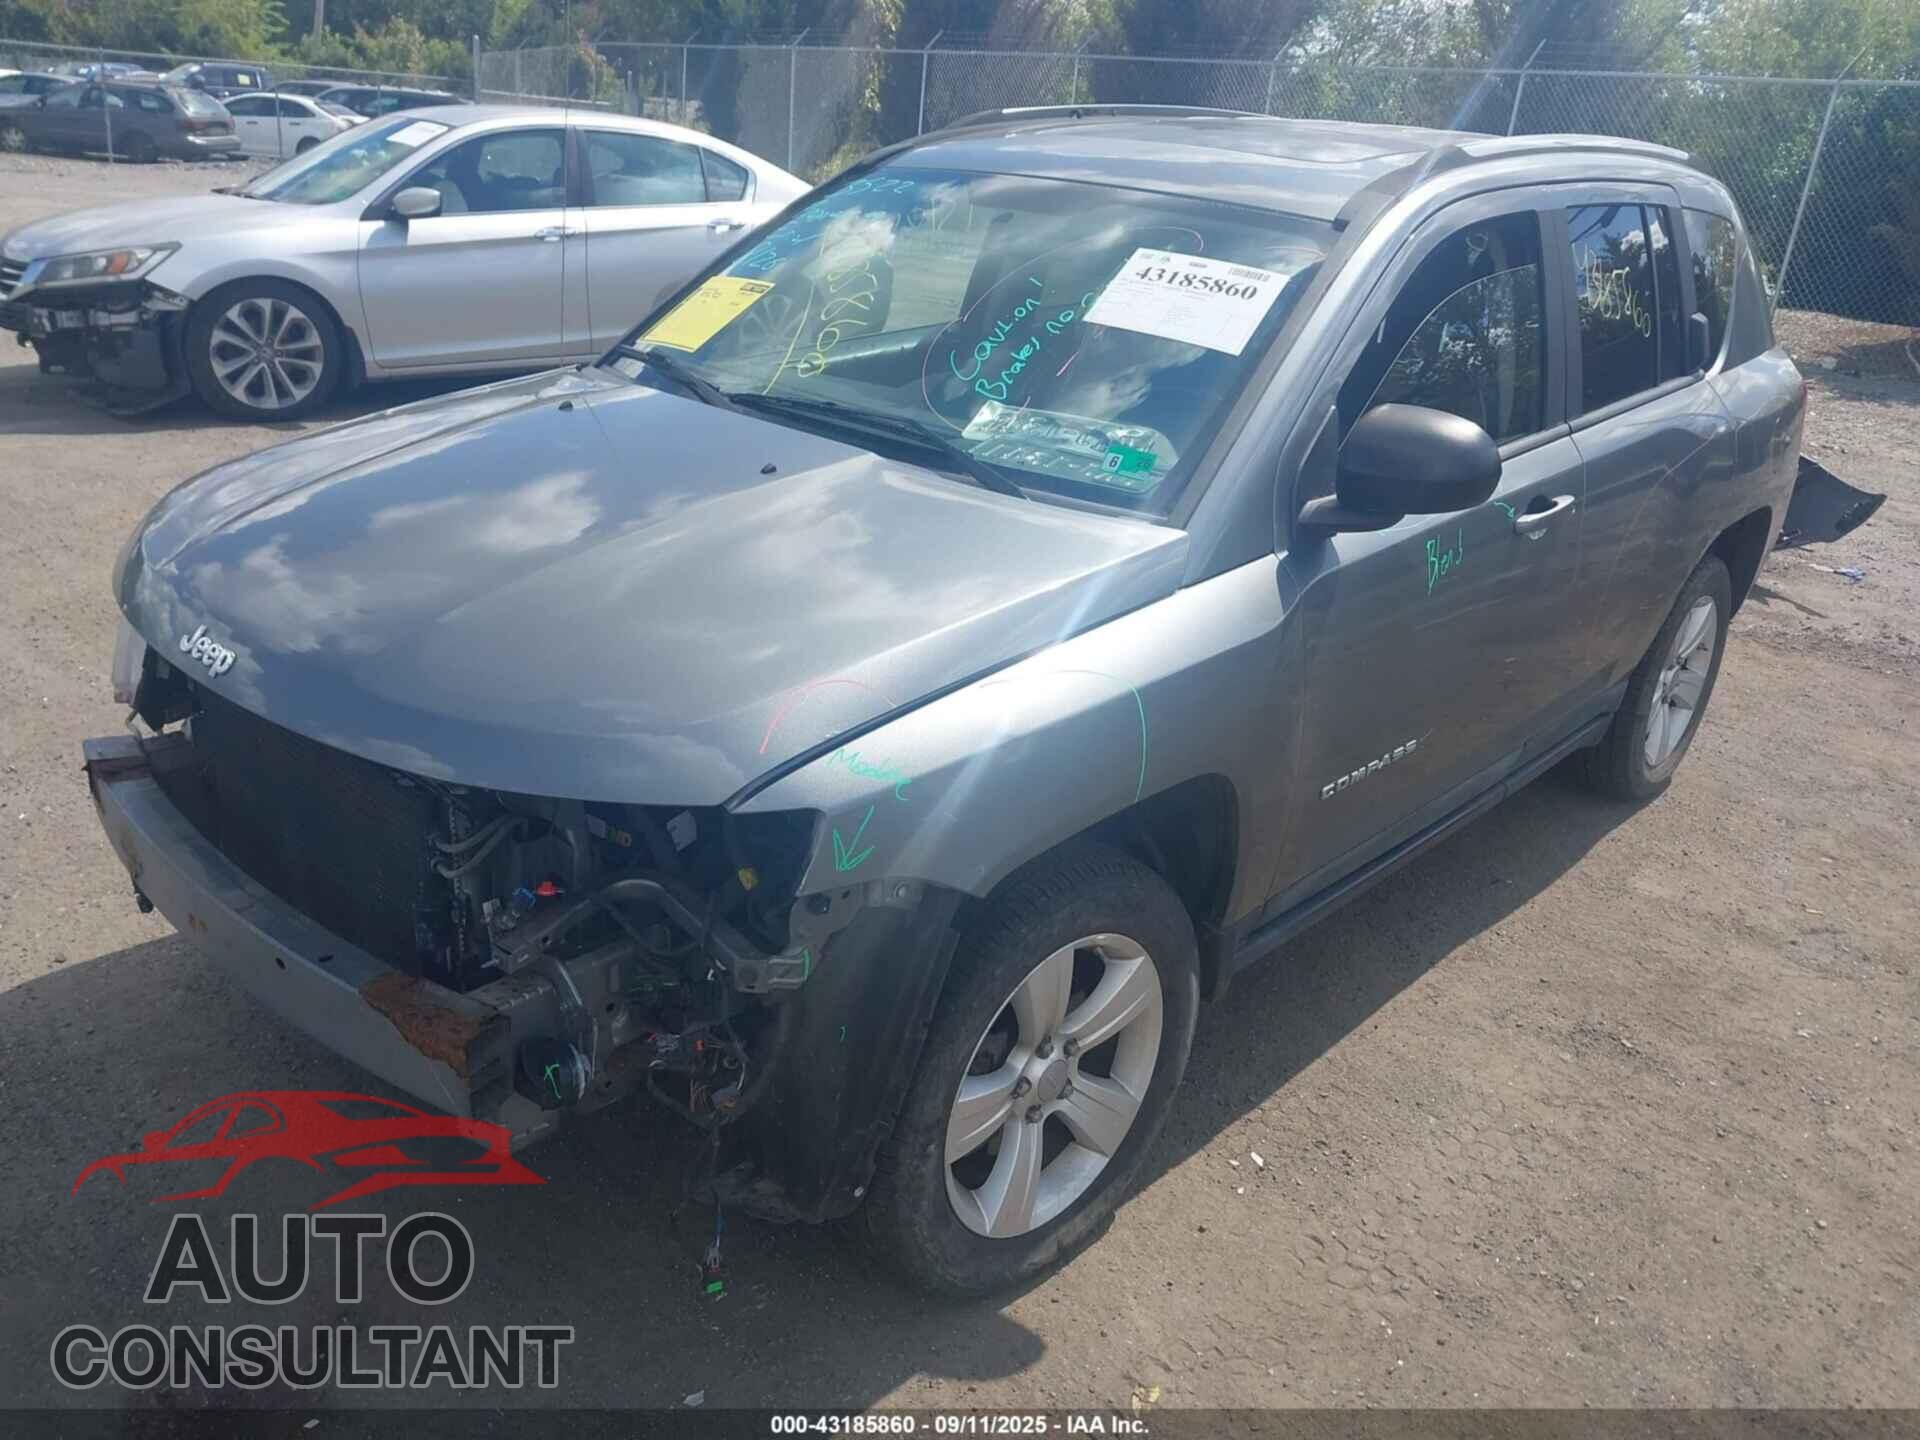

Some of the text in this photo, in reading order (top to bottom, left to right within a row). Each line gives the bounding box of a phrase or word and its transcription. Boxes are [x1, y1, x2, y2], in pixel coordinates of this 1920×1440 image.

[1136, 266, 1258, 300] 43185860
[1108, 455, 1120, 469] 6
[179, 623, 237, 678] Jeep
[1320, 739, 1418, 800] COMPASS
